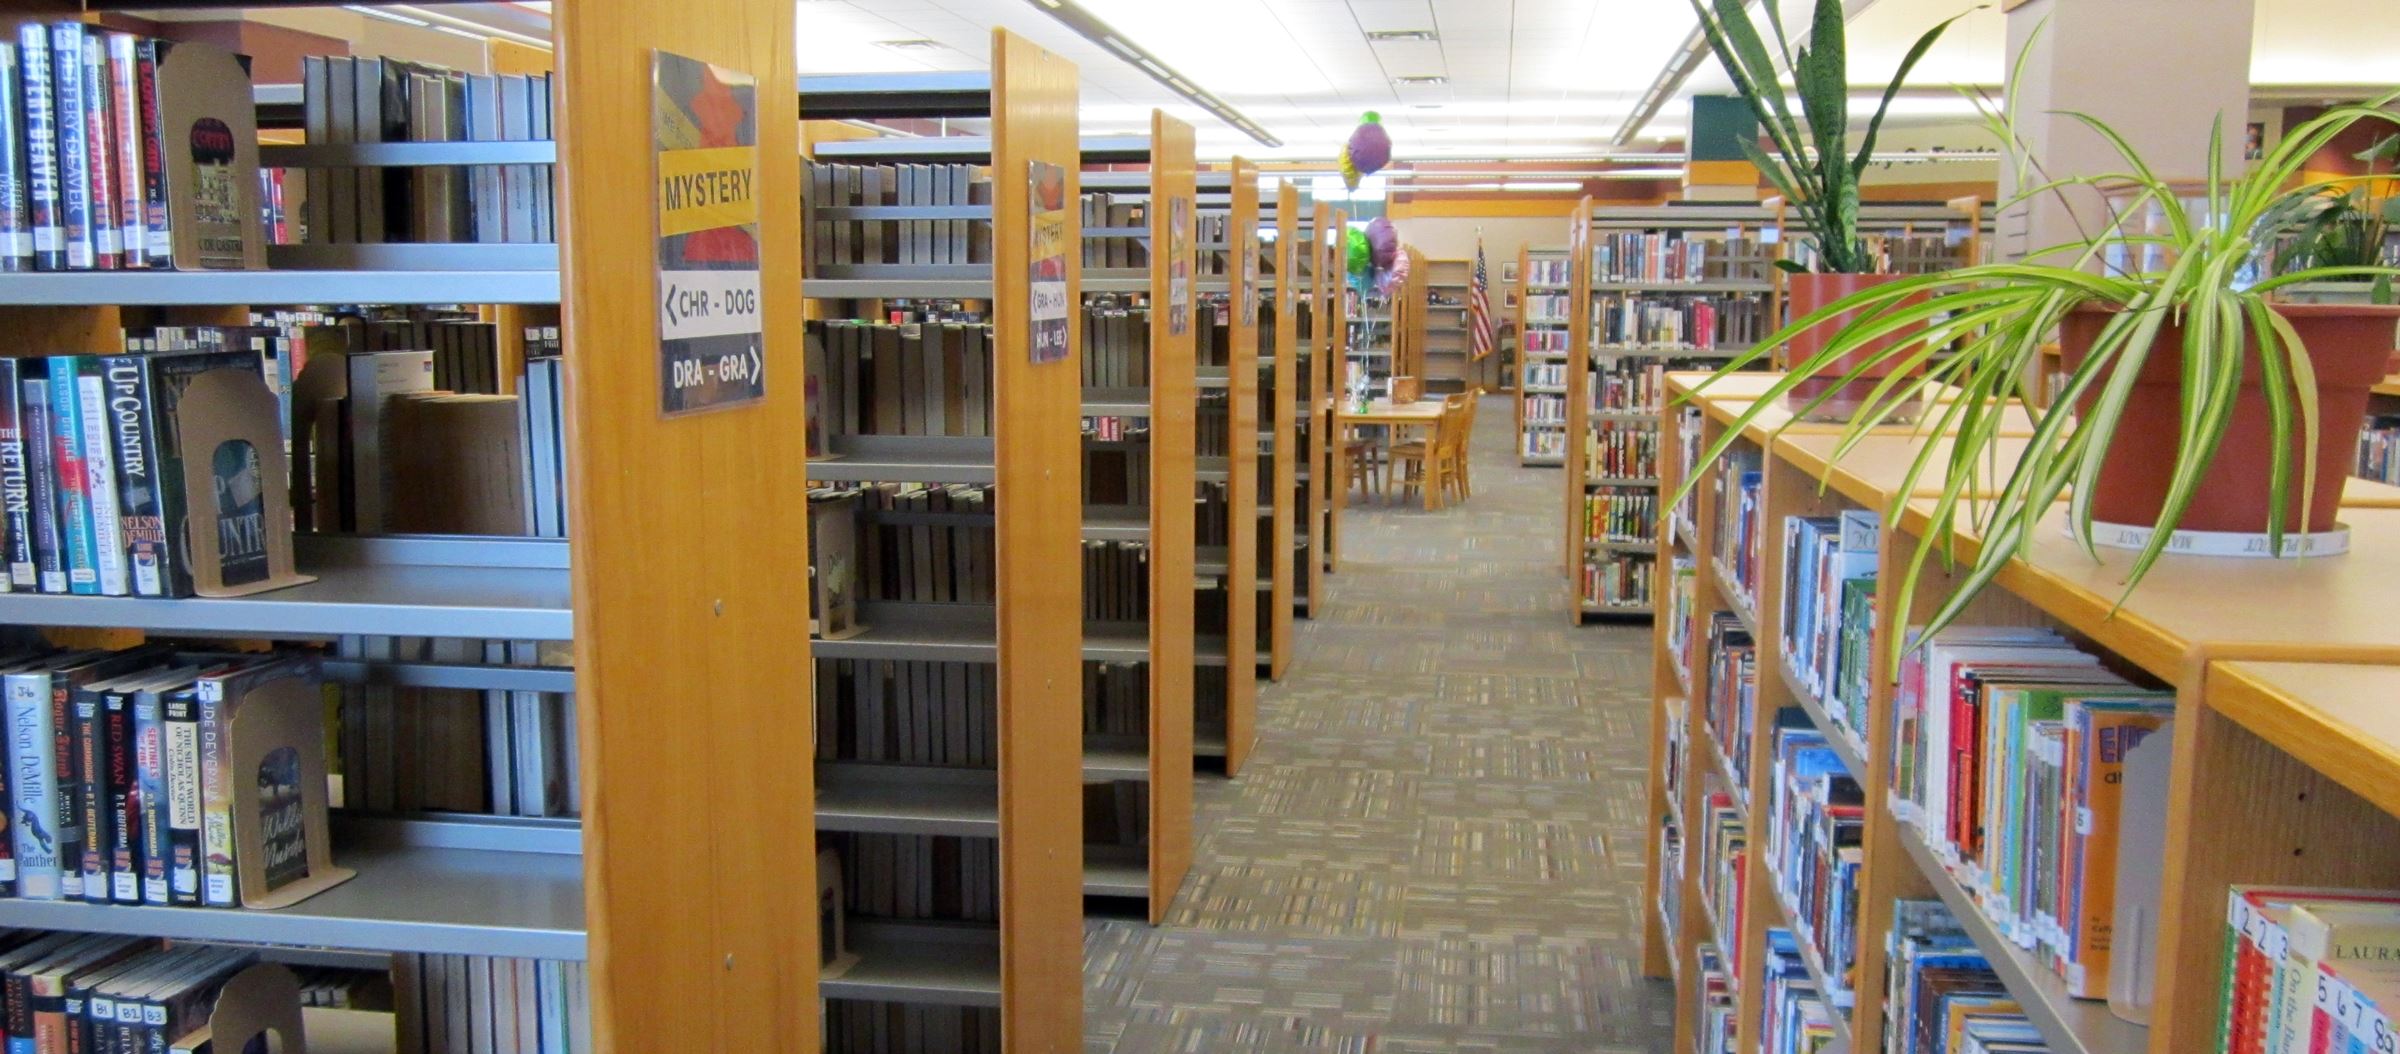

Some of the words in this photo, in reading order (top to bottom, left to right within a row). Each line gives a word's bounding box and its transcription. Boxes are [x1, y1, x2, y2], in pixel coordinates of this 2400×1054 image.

[29, 129, 58, 201] DEAVER
[63, 137, 84, 213] DEAVER
[665, 168, 752, 212] MYSTERY
[679, 290, 709, 318] CHR
[725, 288, 755, 316] DOG
[109, 366, 139, 395] UP
[673, 357, 703, 390] DRA
[719, 353, 748, 383] GRA
[57, 367, 71, 411] NELSON
[0, 428, 21, 439] THE
[111, 396, 145, 478] COUNTRY
[0, 440, 29, 513] RETURN
[120, 515, 162, 530] NELSON
[53, 688, 69, 731] Rogue
[168, 702, 187, 710] LARGE
[204, 702, 217, 729] UDE
[16, 706, 35, 750] Nelson
[82, 722, 92, 737] THE
[111, 714, 122, 742] RED
[175, 726, 183, 739] OF
[183, 728, 192, 748] THE
[55, 735, 72, 778] Island
[83, 738, 94, 784] COMMODORE
[113, 744, 124, 785] SWAN
[139, 746, 147, 767] FIRE
[148, 728, 159, 777] SENTINELS
[175, 741, 185, 791] NICHOLAS
[20, 755, 43, 804] DeMille
[184, 750, 194, 786] SILENT
[178, 793, 187, 825] QUINN
[186, 787, 196, 824] WORLD
[22, 843, 36, 854] The
[2243, 907, 2252, 936] 2
[2258, 920, 2266, 950] 2
[2280, 935, 2288, 960] 3
[2289, 968, 2301, 994] On
[2318, 975, 2327, 1002] 5
[123, 1008, 140, 1020] B2
[147, 1009, 162, 1022] B3
[2286, 996, 2297, 1022] the
[2337, 990, 2346, 1016] 6
[2353, 1001, 2363, 1029] 7
[2374, 1018, 2385, 1050] 8
